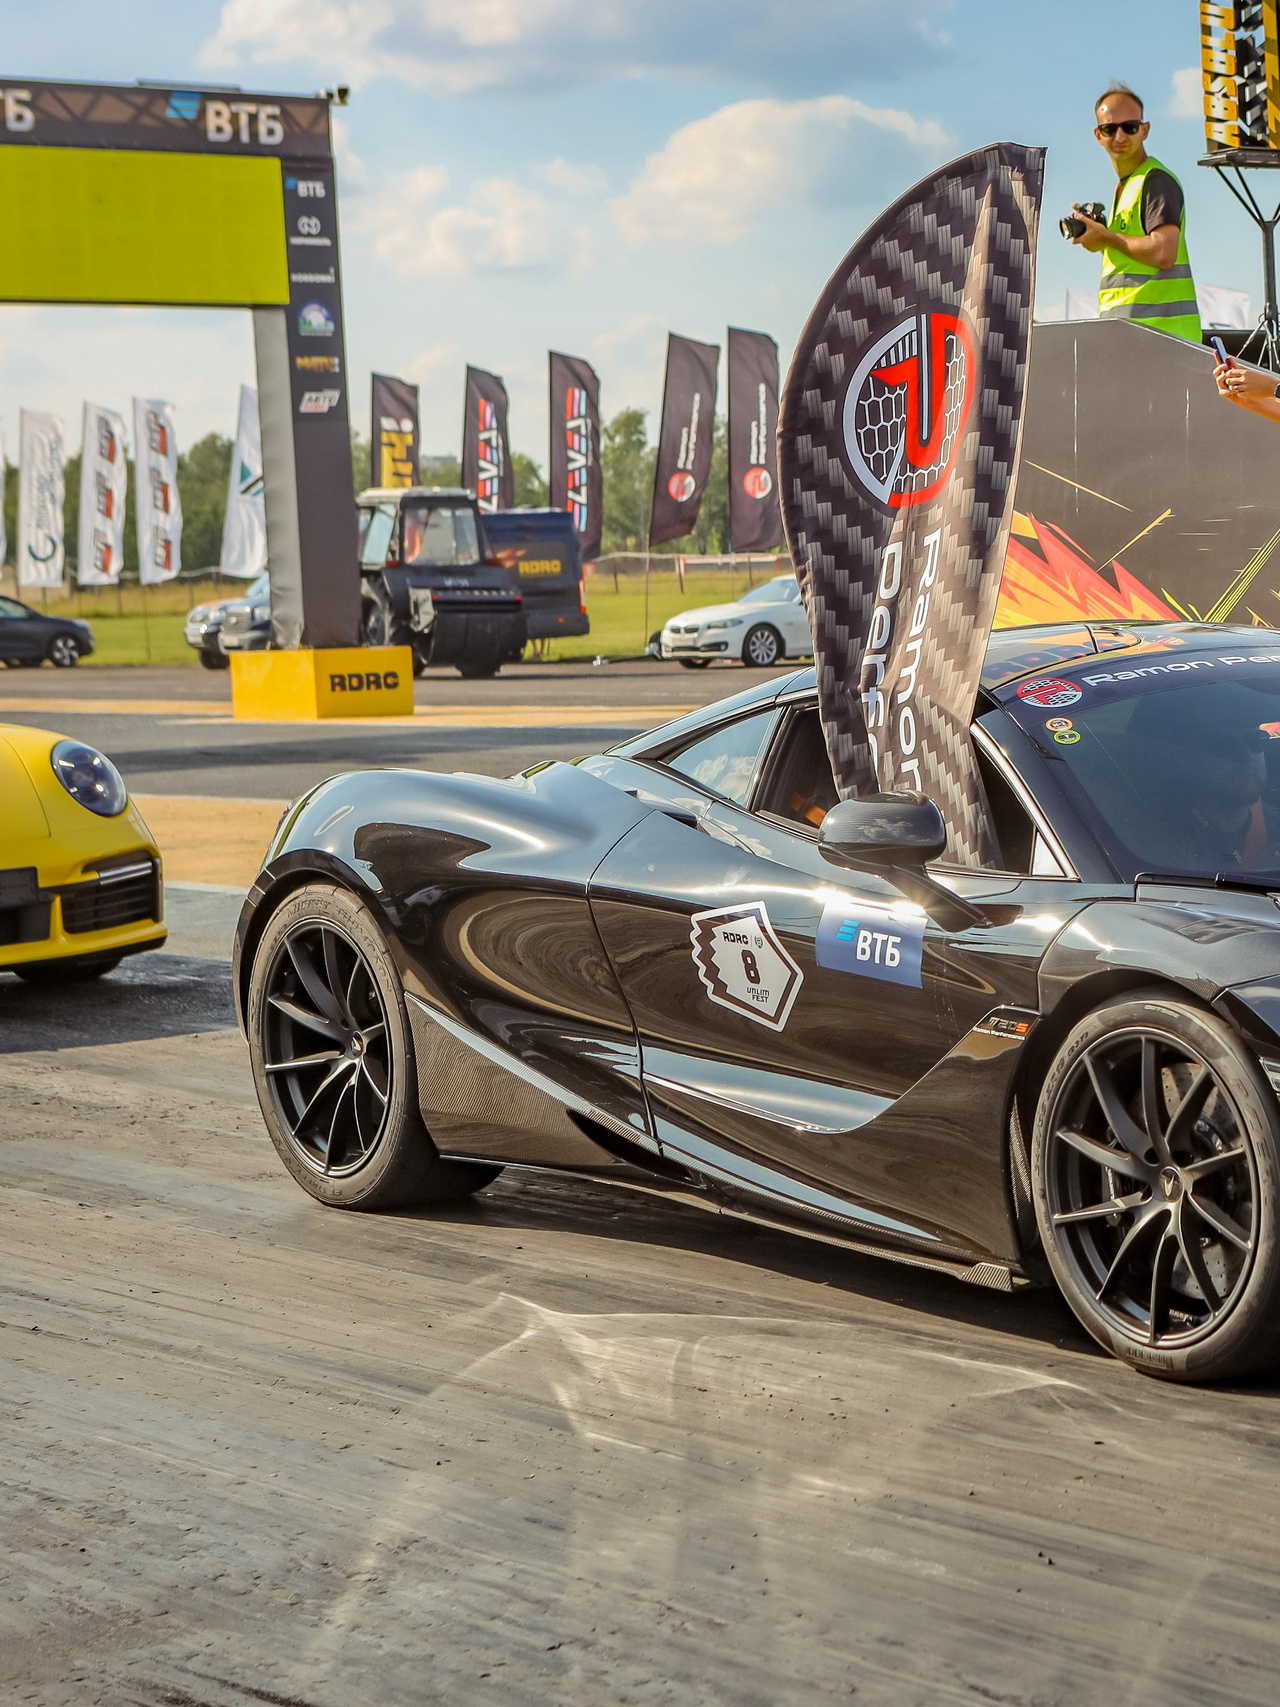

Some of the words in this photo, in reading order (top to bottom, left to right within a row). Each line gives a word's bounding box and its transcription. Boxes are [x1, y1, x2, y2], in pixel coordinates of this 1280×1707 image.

[0, 88, 35, 132] Б
[206, 101, 284, 145] ВТБ
[297, 181, 326, 198] ВТБ
[897, 527, 942, 793] Ramon
[329, 671, 399, 692] RDRC
[1081, 661, 1215, 687] Ramon
[722, 931, 749, 946] RDRC
[857, 930, 901, 967] ВТБ
[741, 949, 761, 985] 8
[752, 994, 769, 1003] FEST
[989, 1016, 1029, 1033] 720S
